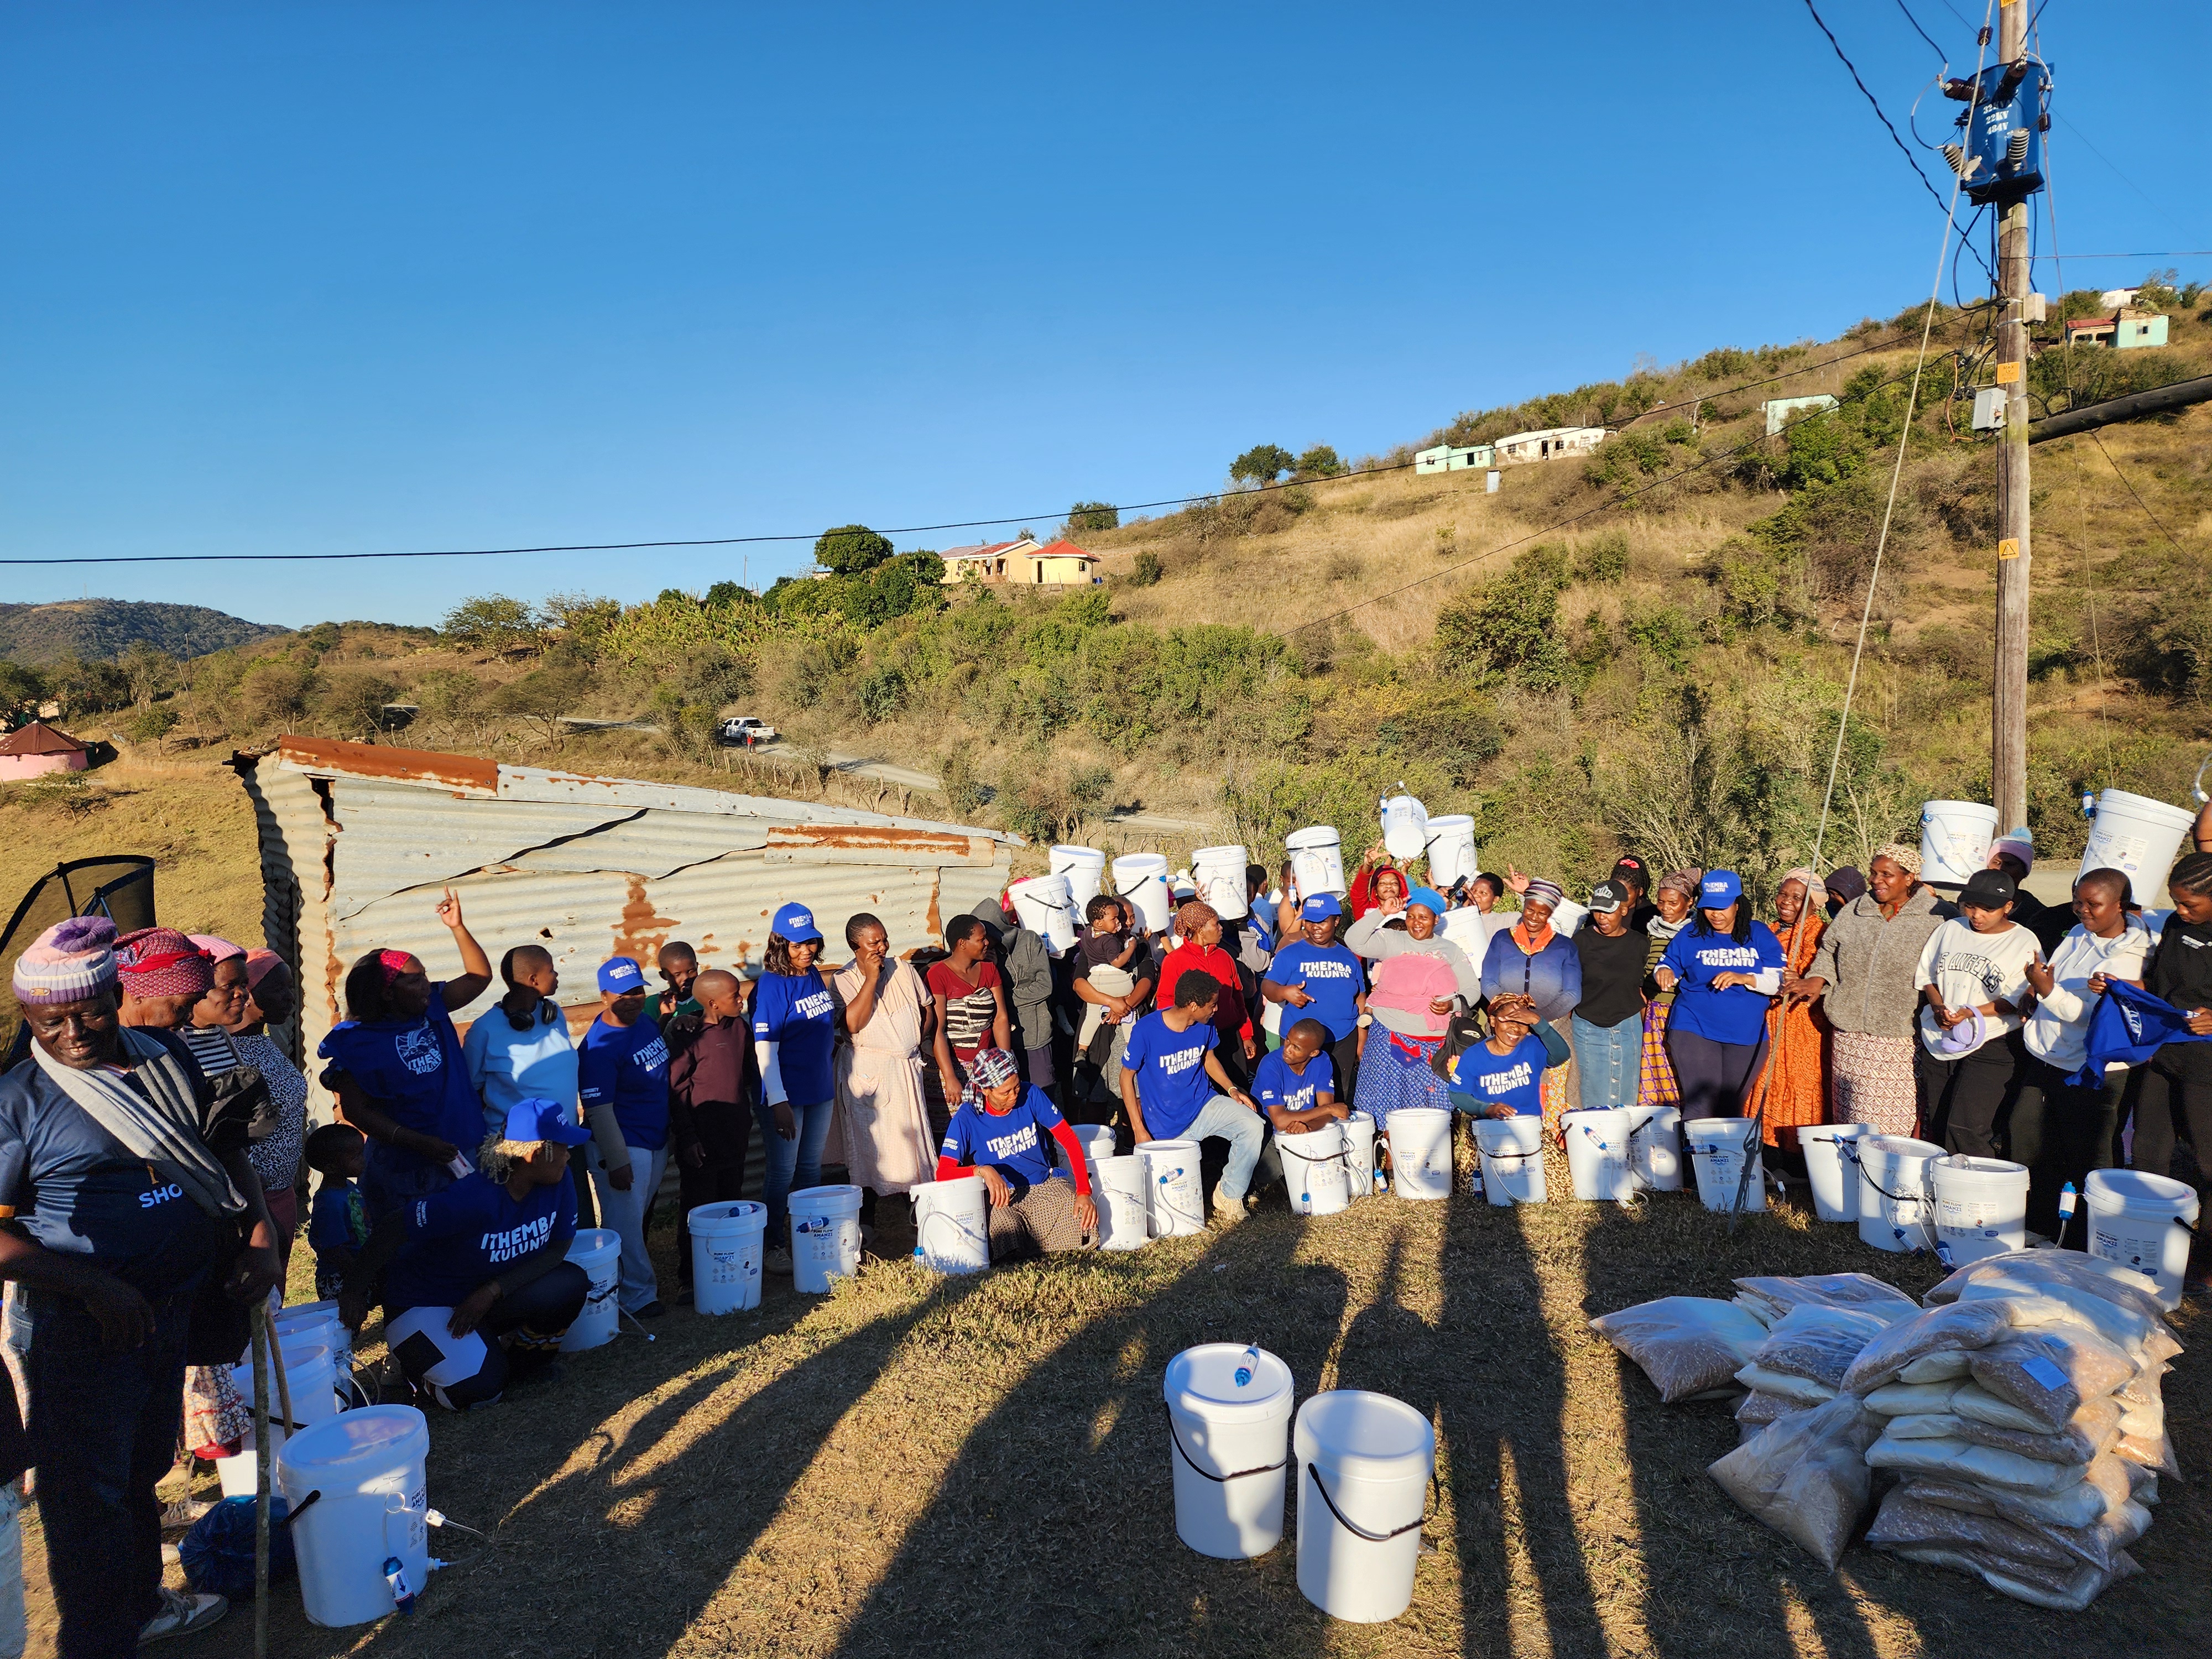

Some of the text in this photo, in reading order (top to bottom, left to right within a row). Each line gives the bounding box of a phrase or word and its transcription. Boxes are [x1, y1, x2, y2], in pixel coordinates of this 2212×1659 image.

[1986, 110, 2009, 124] 22KV
[1986, 121, 2009, 135] 484V
[1695, 947, 1760, 959] ITHEMBA
[1300, 961, 1352, 974] ITHEMBA
[1702, 957, 1755, 967] KULUNTU
[1306, 970, 1350, 978] KULUNTU
[1948, 952, 2006, 993] ANGELES
[805, 1000, 835, 1020] KULUNT
[645, 1047, 671, 1072] KULUNT
[1480, 1061, 1533, 1088] ITHEMBA
[1488, 1075, 1531, 1095] KULUNTU
[489, 1229, 551, 1262] KULUNTU
[2096, 1235, 2117, 1247] AMANZI
